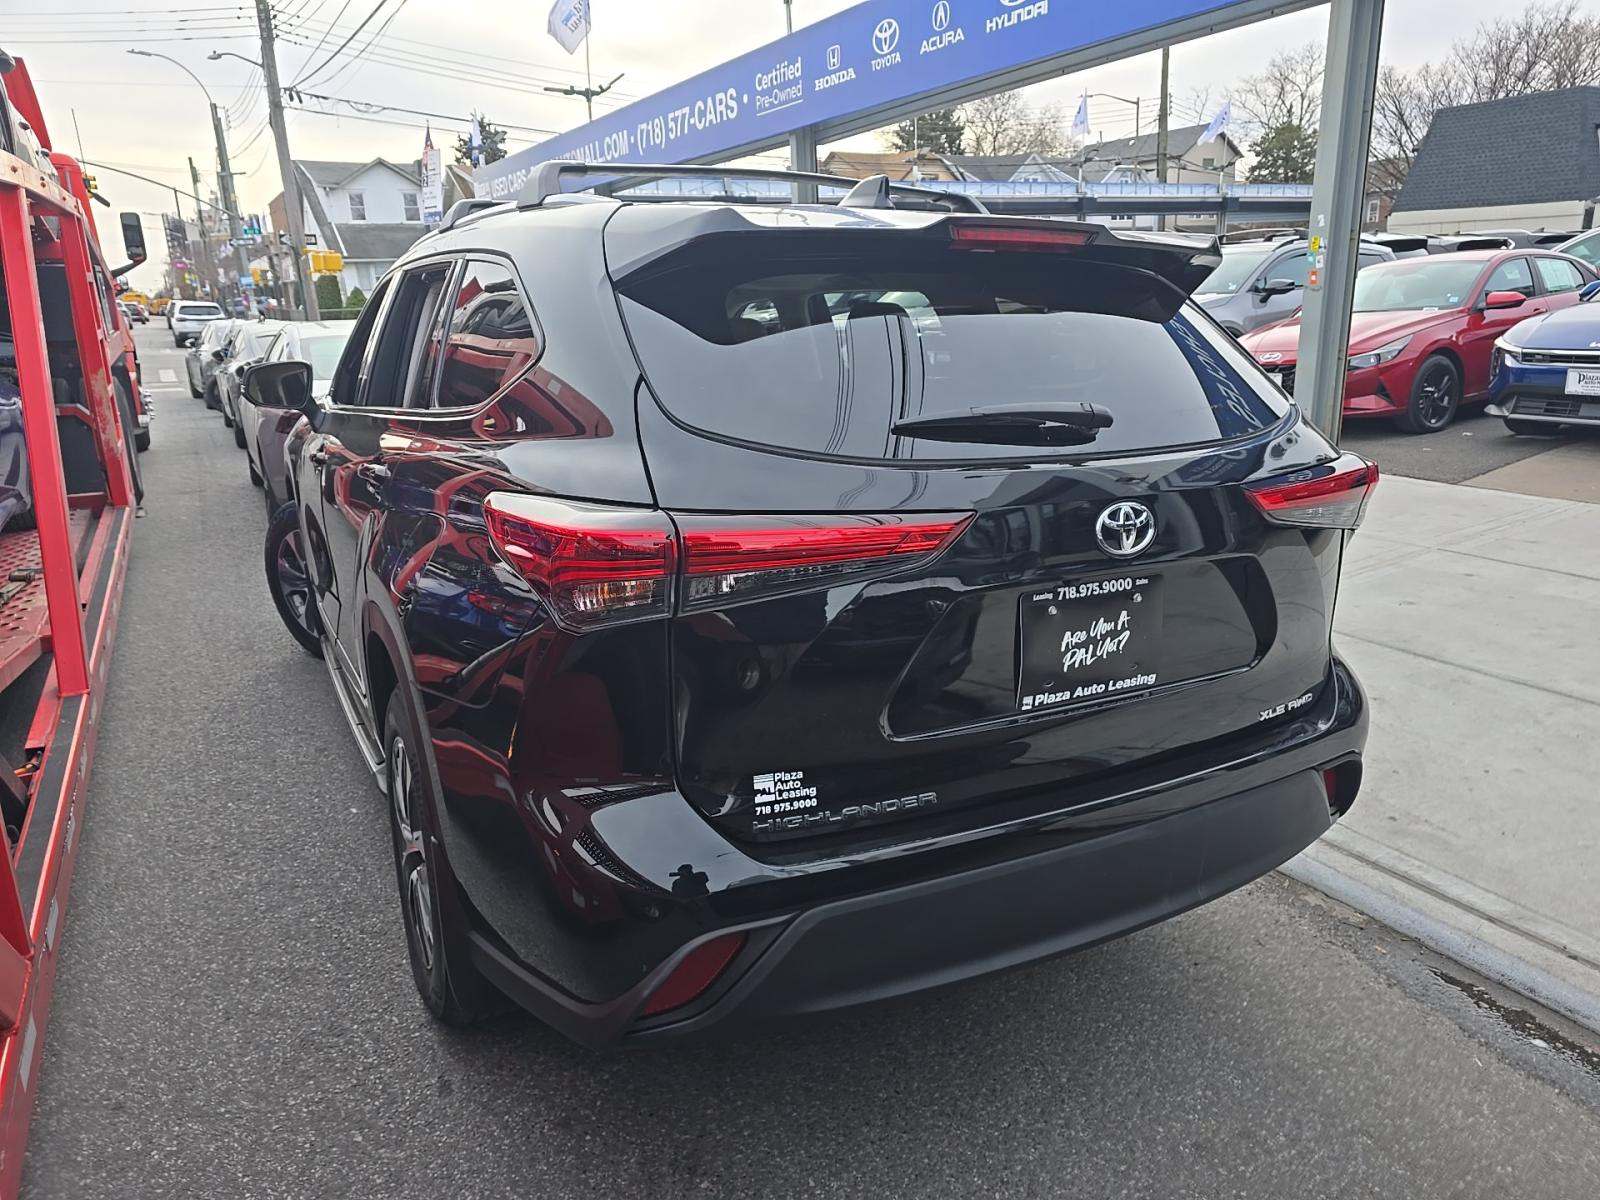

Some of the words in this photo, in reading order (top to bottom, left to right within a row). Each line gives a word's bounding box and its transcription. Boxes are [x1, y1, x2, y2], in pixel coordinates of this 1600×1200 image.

[985, 1, 1049, 33] HYUNDAI
[920, 27, 965, 55] ACURA
[755, 57, 802, 91] Certified
[871, 51, 901, 71] TOYOTA
[814, 67, 856, 91] HONDA
[756, 80, 803, 111] Pre-Owned
[491, 176, 508, 198] USED
[637, 115, 666, 156] (718)
[668, 87, 738, 140] 577-CARS
[1057, 577, 1133, 601] 718.975.9000
[1089, 617, 1115, 640] You
[1117, 610, 1131, 631] A
[1062, 644, 1098, 673] PAL
[1034, 691, 1071, 706] Plaza
[1073, 683, 1106, 699] Auto
[1107, 673, 1157, 692] Leasing
[1259, 703, 1286, 721] XLE
[1287, 692, 1313, 711] AWD
[774, 771, 804, 782] Plaza
[775, 780, 801, 791] Auto
[755, 806, 772, 816] 718
[773, 798, 818, 812] 975.9000
[775, 786, 817, 801] Leasing
[752, 791, 938, 833] HIGHLANDER
